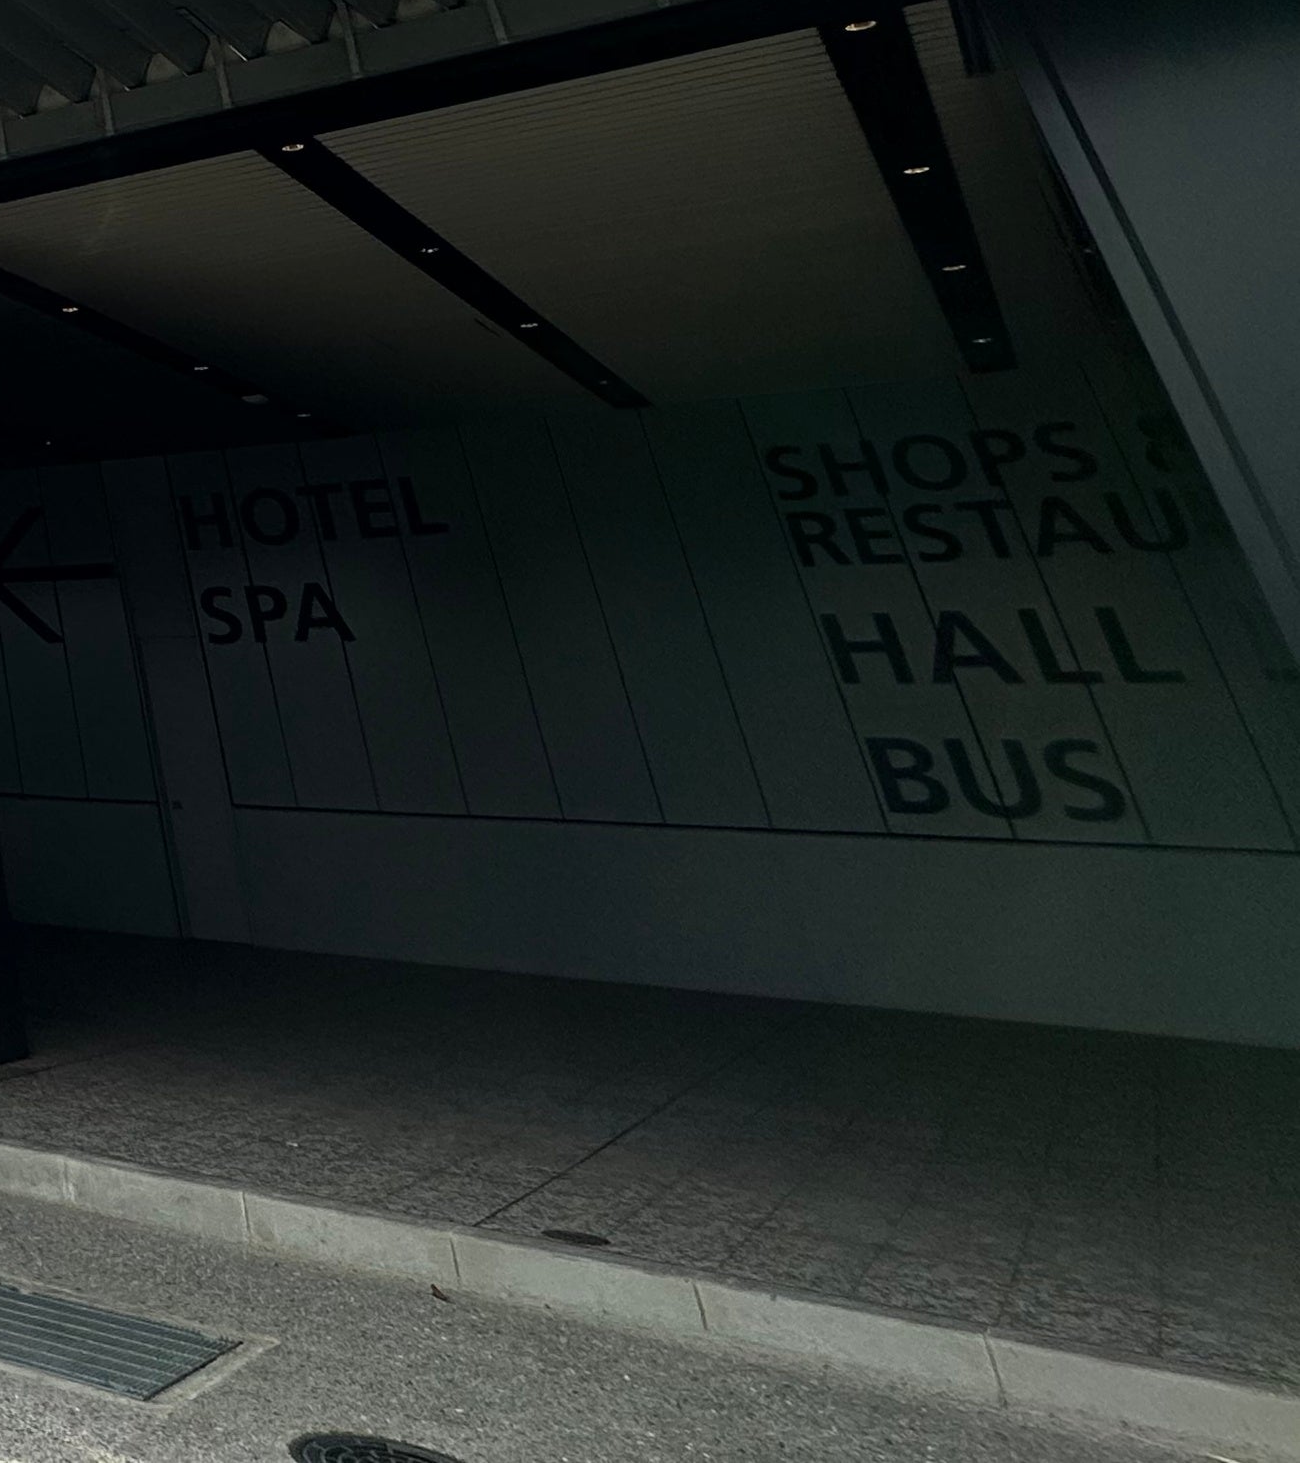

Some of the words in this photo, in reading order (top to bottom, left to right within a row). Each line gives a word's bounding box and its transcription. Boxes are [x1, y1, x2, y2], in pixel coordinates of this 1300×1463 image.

[764, 421, 1098, 501] SHOPS
[178, 476, 450, 551] HOTEL
[785, 488, 1192, 567] RESTAU
[199, 582, 356, 644] SPA
[820, 606, 1187, 684] HALL
[865, 738, 1127, 823] BUS
